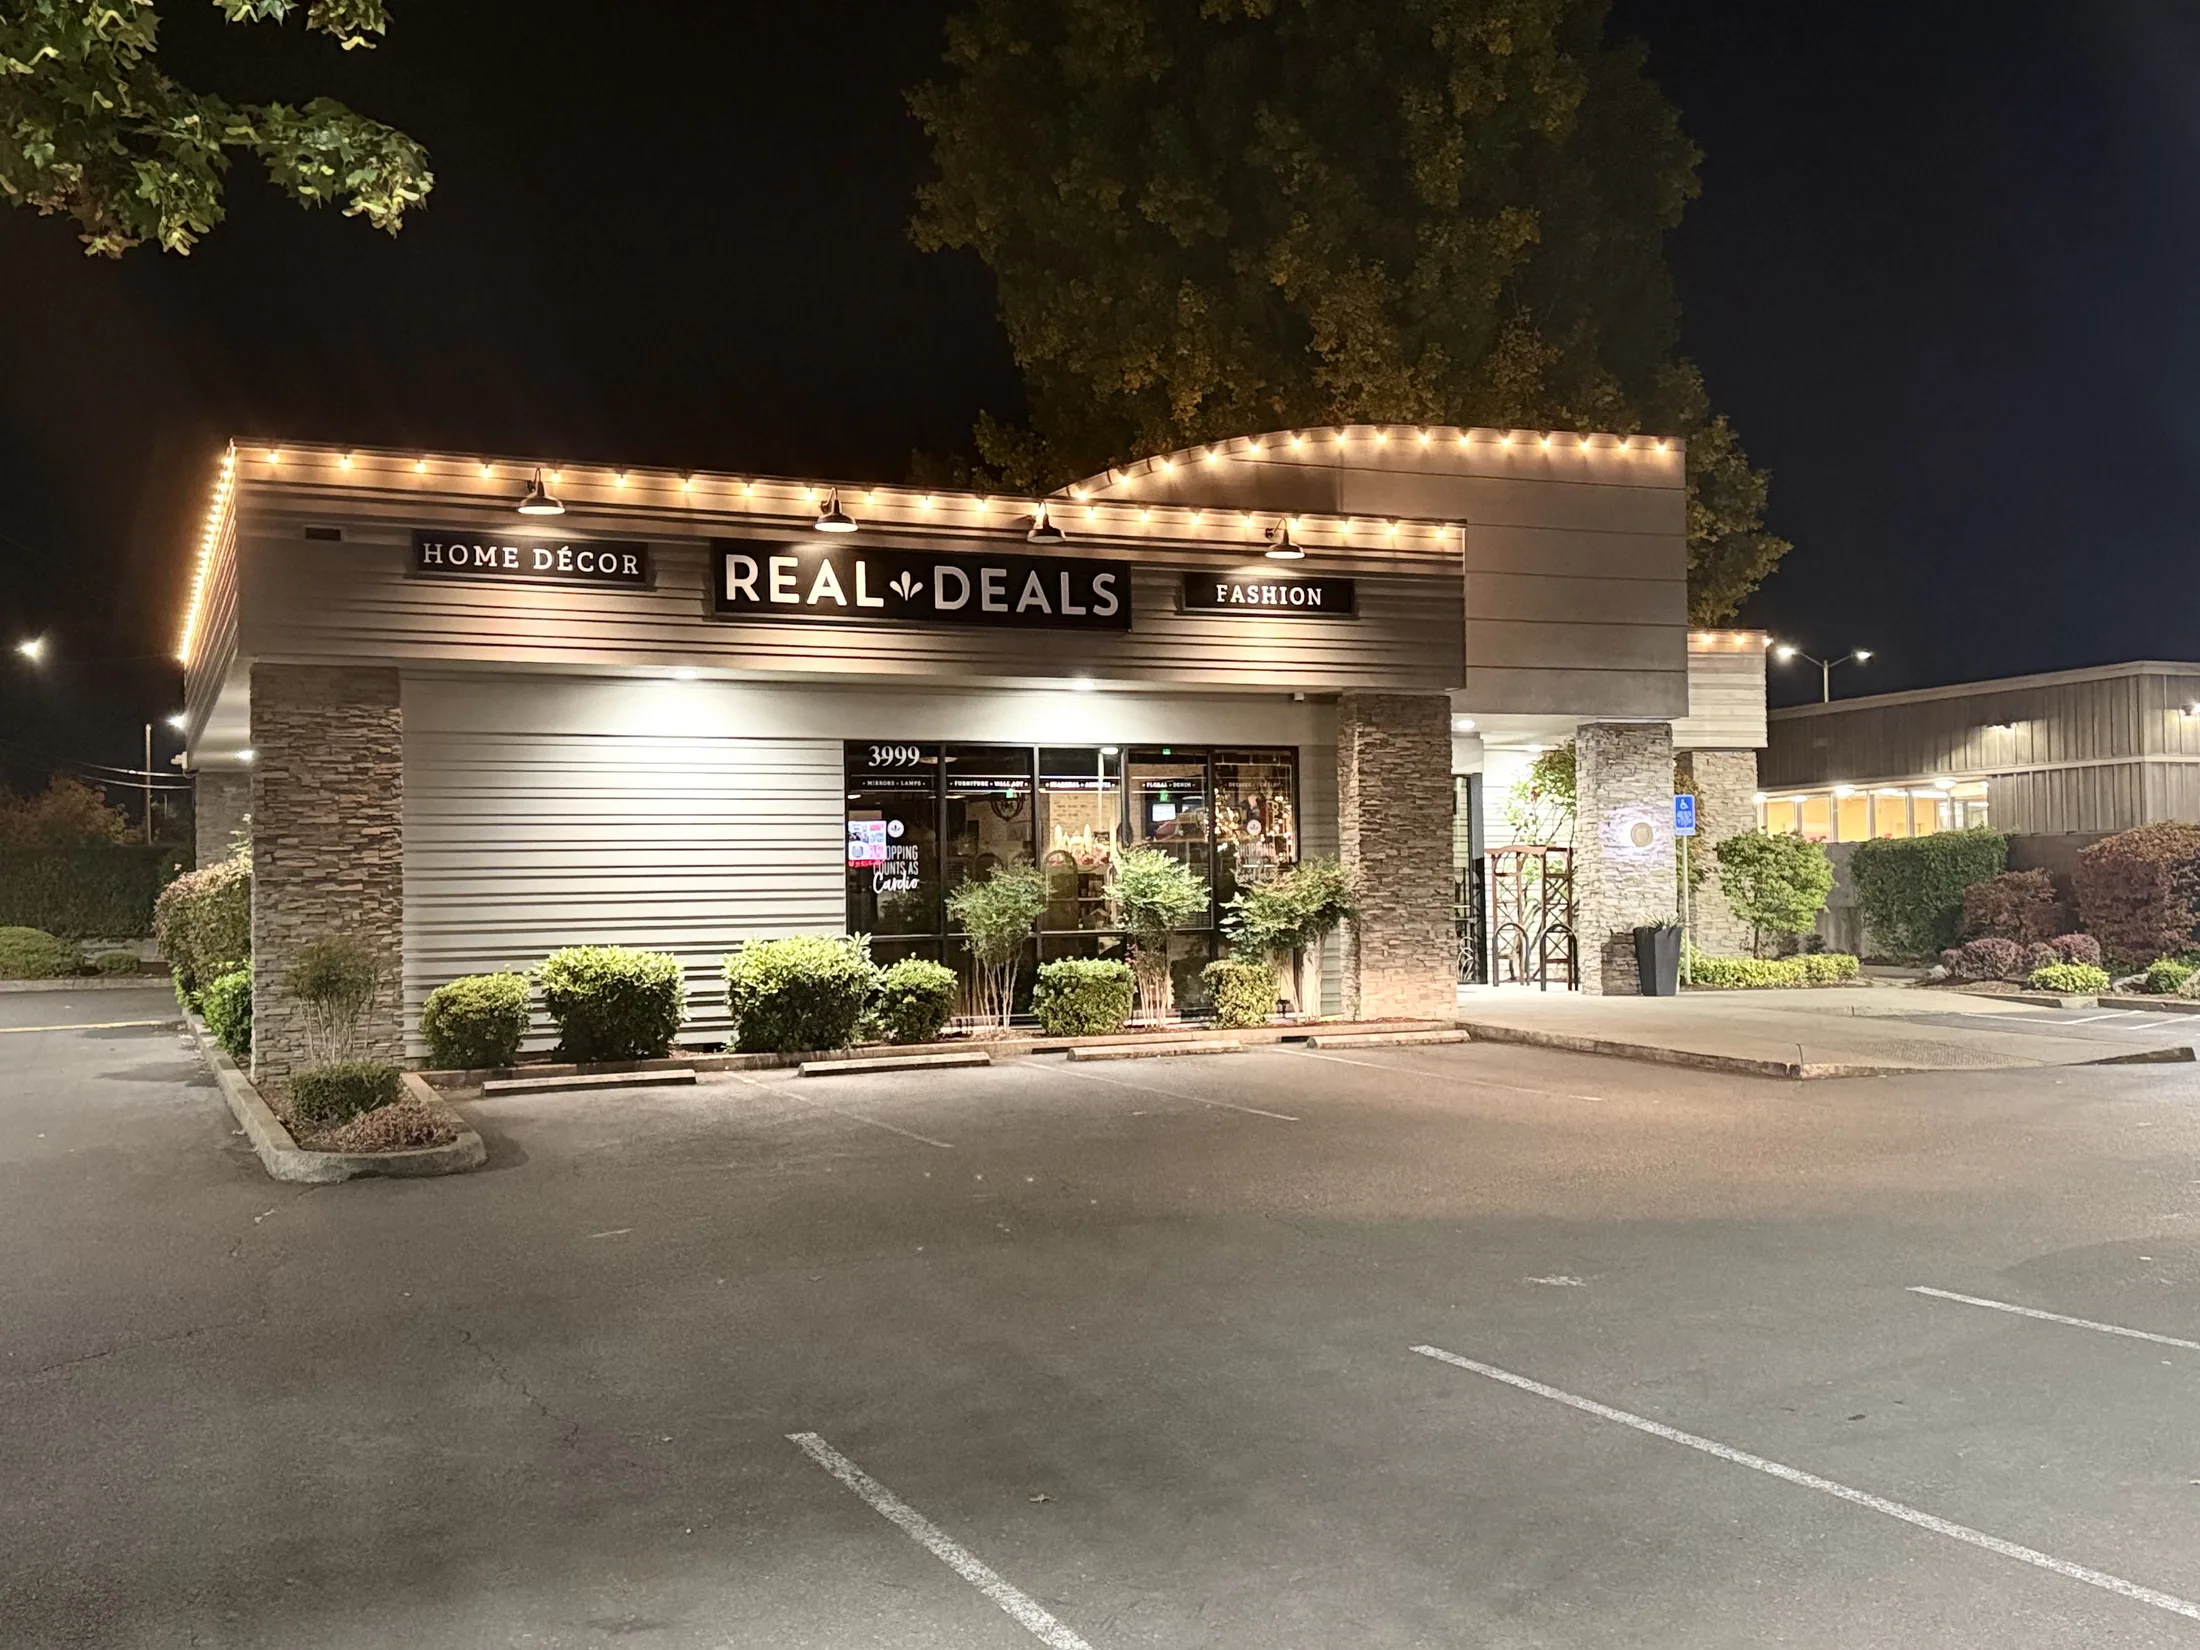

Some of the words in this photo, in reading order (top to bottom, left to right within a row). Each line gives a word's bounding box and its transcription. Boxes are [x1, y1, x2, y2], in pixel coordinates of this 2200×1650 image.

[423, 543, 519, 568] HOME
[533, 546, 638, 574] DÉCOR
[726, 554, 884, 607] REAL
[934, 565, 1119, 616] DEALS
[1216, 584, 1322, 605] FASHION
[868, 745, 920, 767] 3999
[886, 845, 919, 860] OPPING
[873, 861, 906, 876] COUNTS
[907, 861, 919, 876] AS
[873, 869, 920, 894] Cardio
